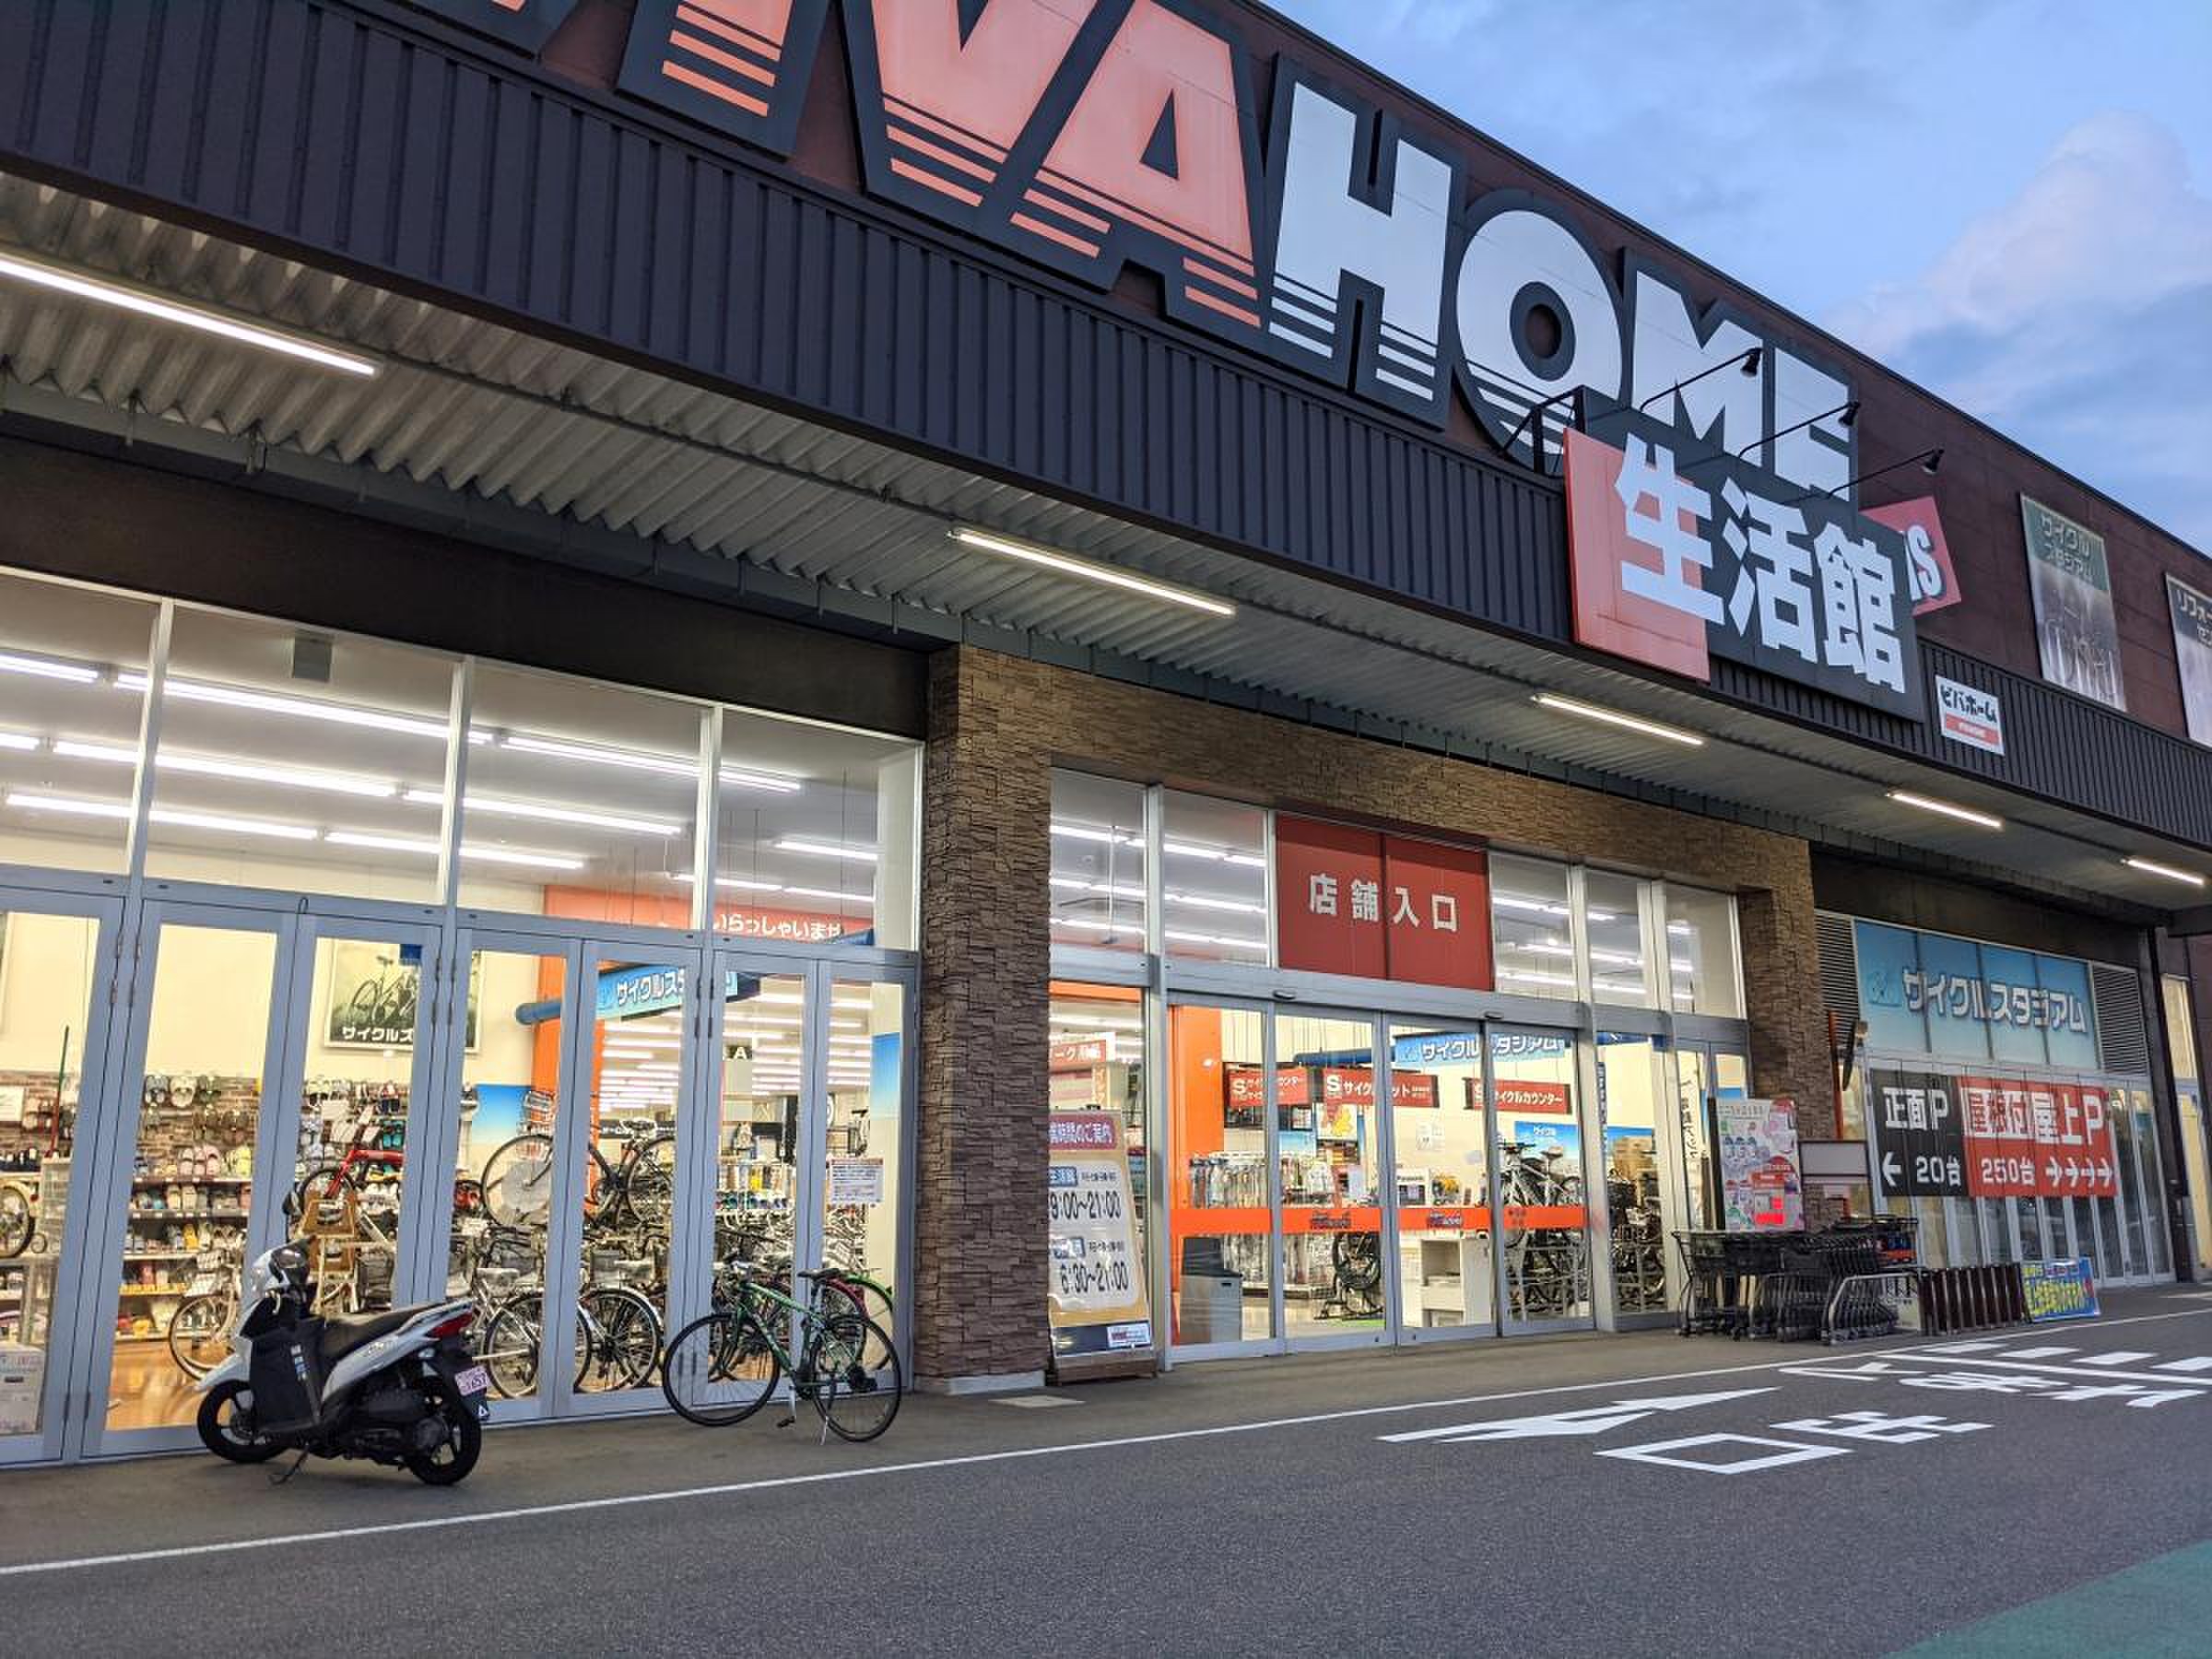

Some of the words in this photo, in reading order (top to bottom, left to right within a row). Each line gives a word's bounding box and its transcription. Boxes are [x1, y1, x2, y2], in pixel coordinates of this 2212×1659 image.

[1615, 432, 1905, 693] 生活館
[1939, 684, 1998, 724] ビバホーム
[1310, 873, 1459, 933] 店舗入口
[1902, 967, 2088, 1034] サイクルスタジアム
[1422, 1035, 1559, 1060] サイクルタジアム
[1495, 1088, 1564, 1105] イクルカウンター
[1882, 1087, 1949, 1131] 正面P
[1916, 1155, 1962, 1187] 20台
[1982, 1156, 2035, 1187] 250台
